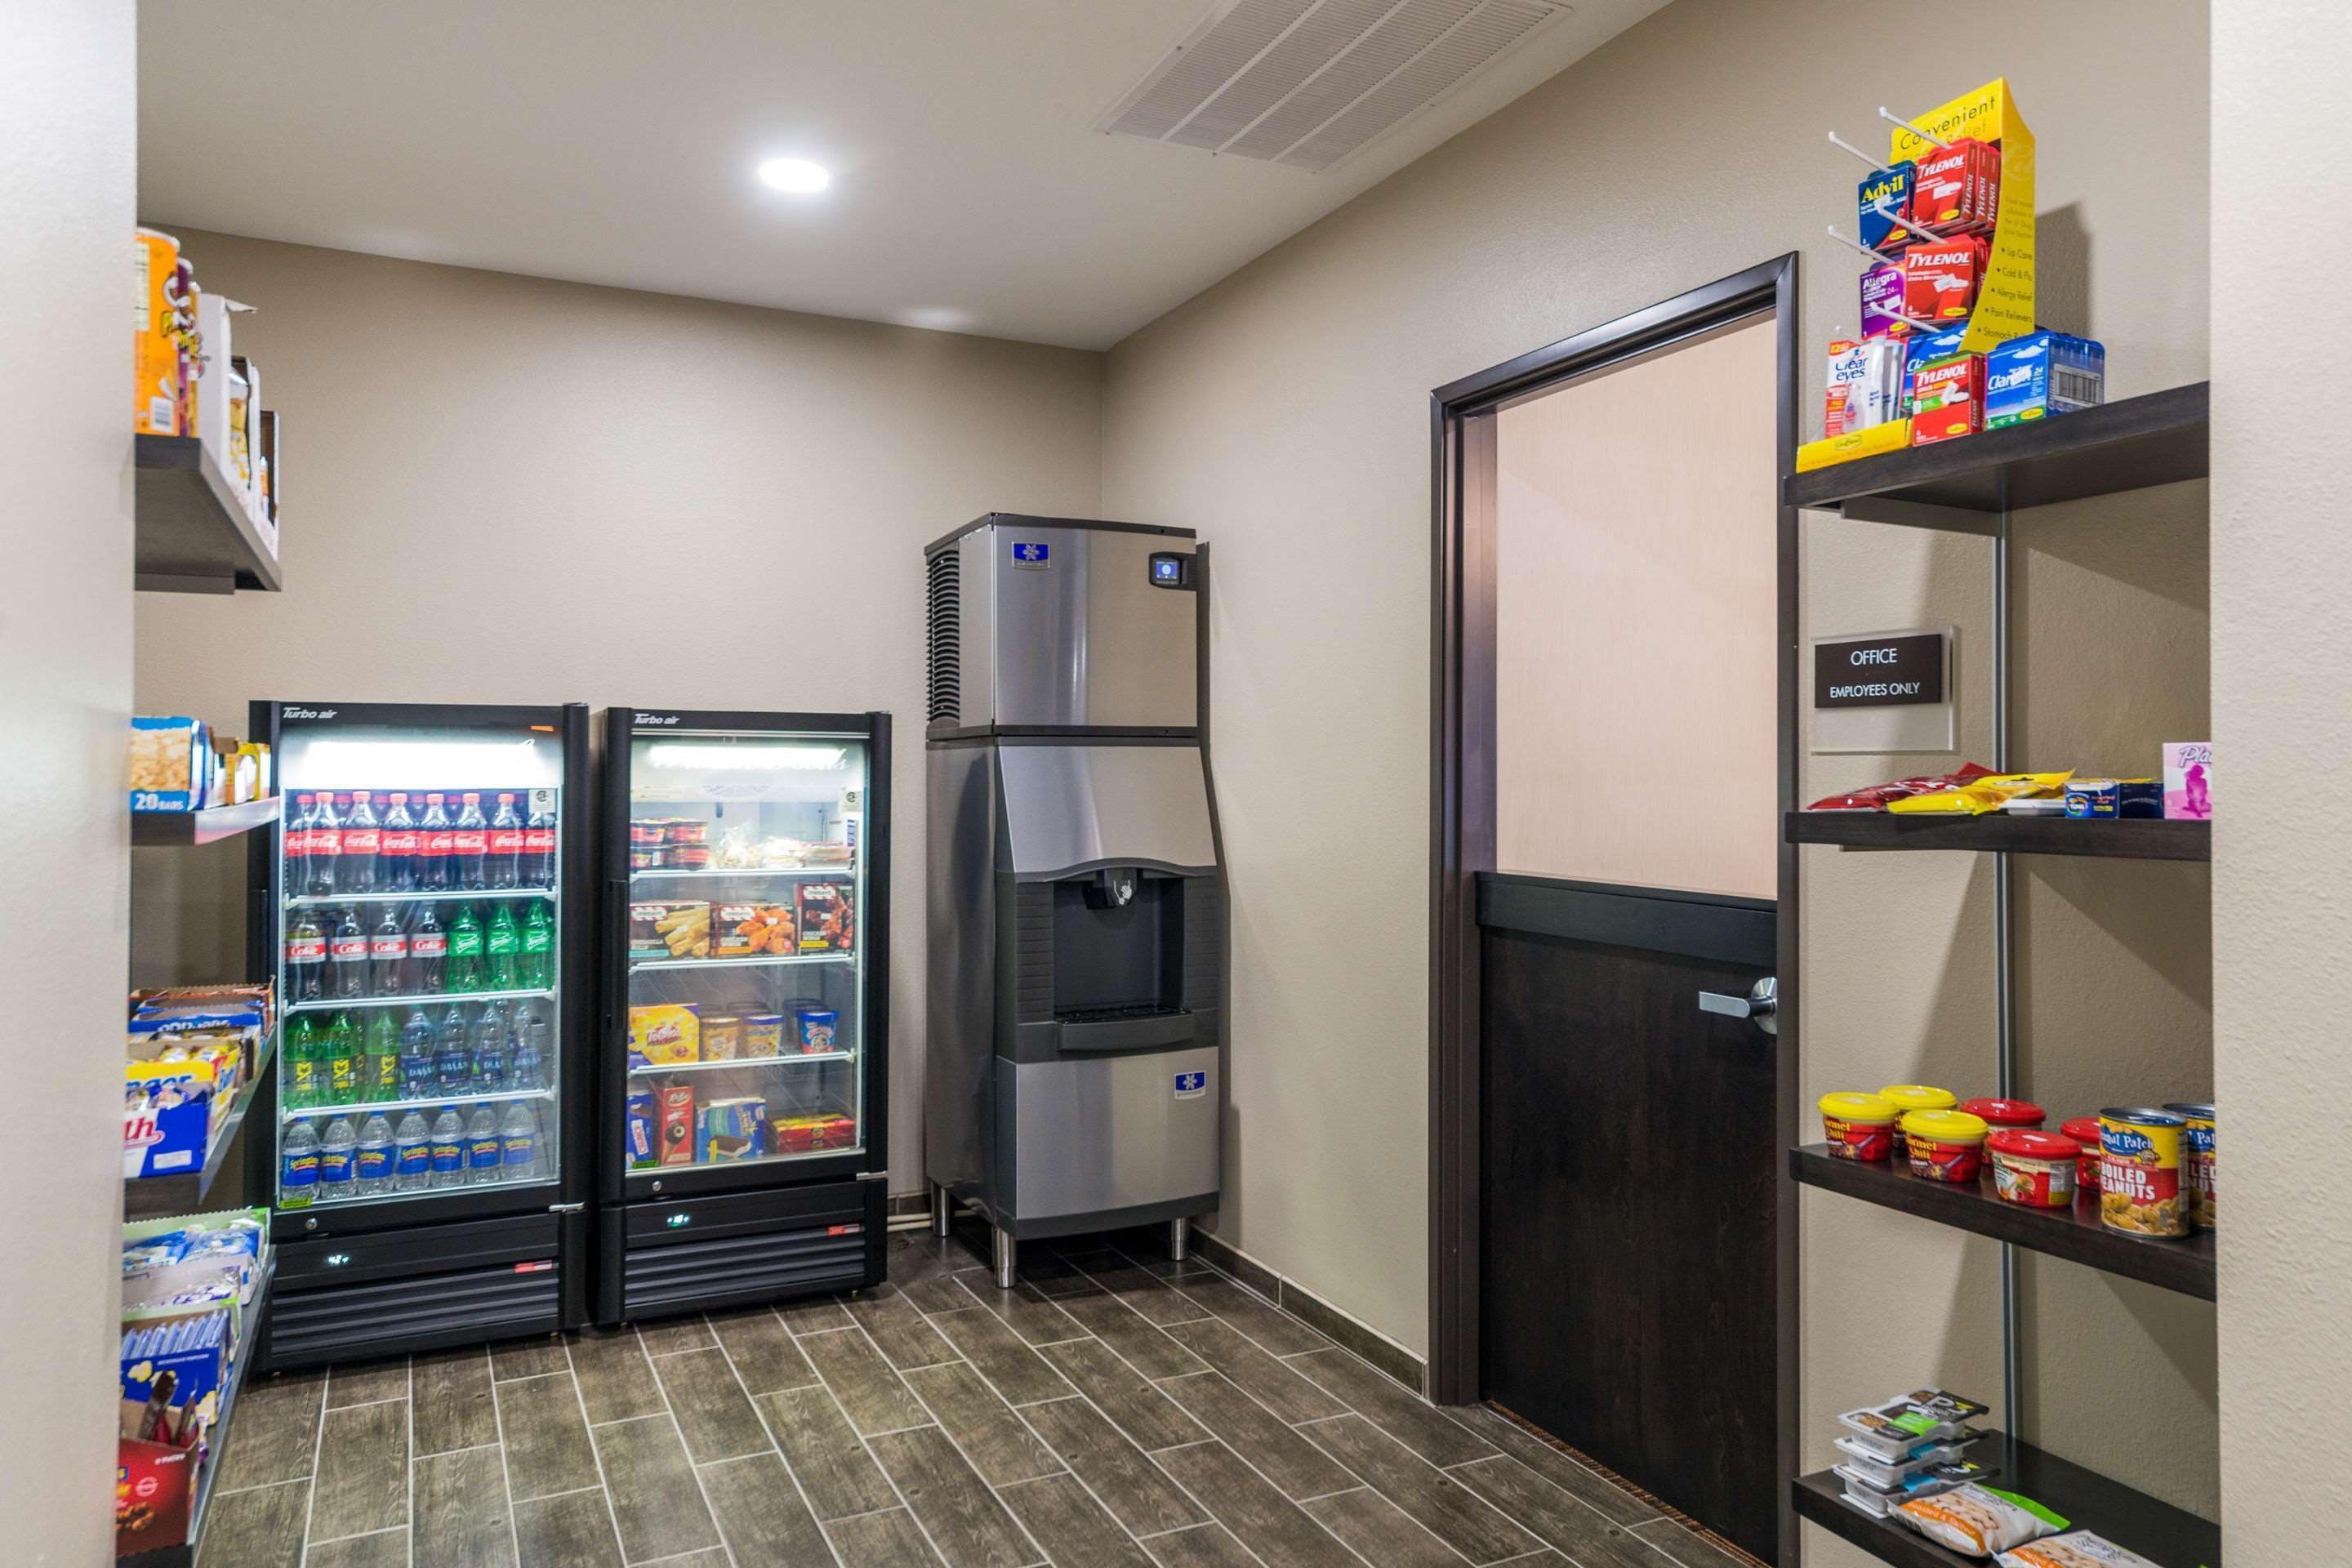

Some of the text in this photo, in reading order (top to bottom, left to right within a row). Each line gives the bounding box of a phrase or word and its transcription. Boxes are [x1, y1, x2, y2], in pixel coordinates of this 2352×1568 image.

[1917, 154, 1965, 180] TYLENOL
[1861, 174, 1904, 203] Advil
[1909, 252, 1971, 268] TYLENOL
[1863, 272, 1897, 289] Allegra
[1836, 368, 1866, 382] eyes
[1917, 363, 1968, 388] TYLENOL
[1851, 648, 1897, 666] OFFICE
[1830, 682, 1921, 698] EMPLOYEES ONLY
[283, 707, 318, 719] Turbo
[634, 713, 663, 724] Turbo
[2123, 1135, 2154, 1150] Patch
